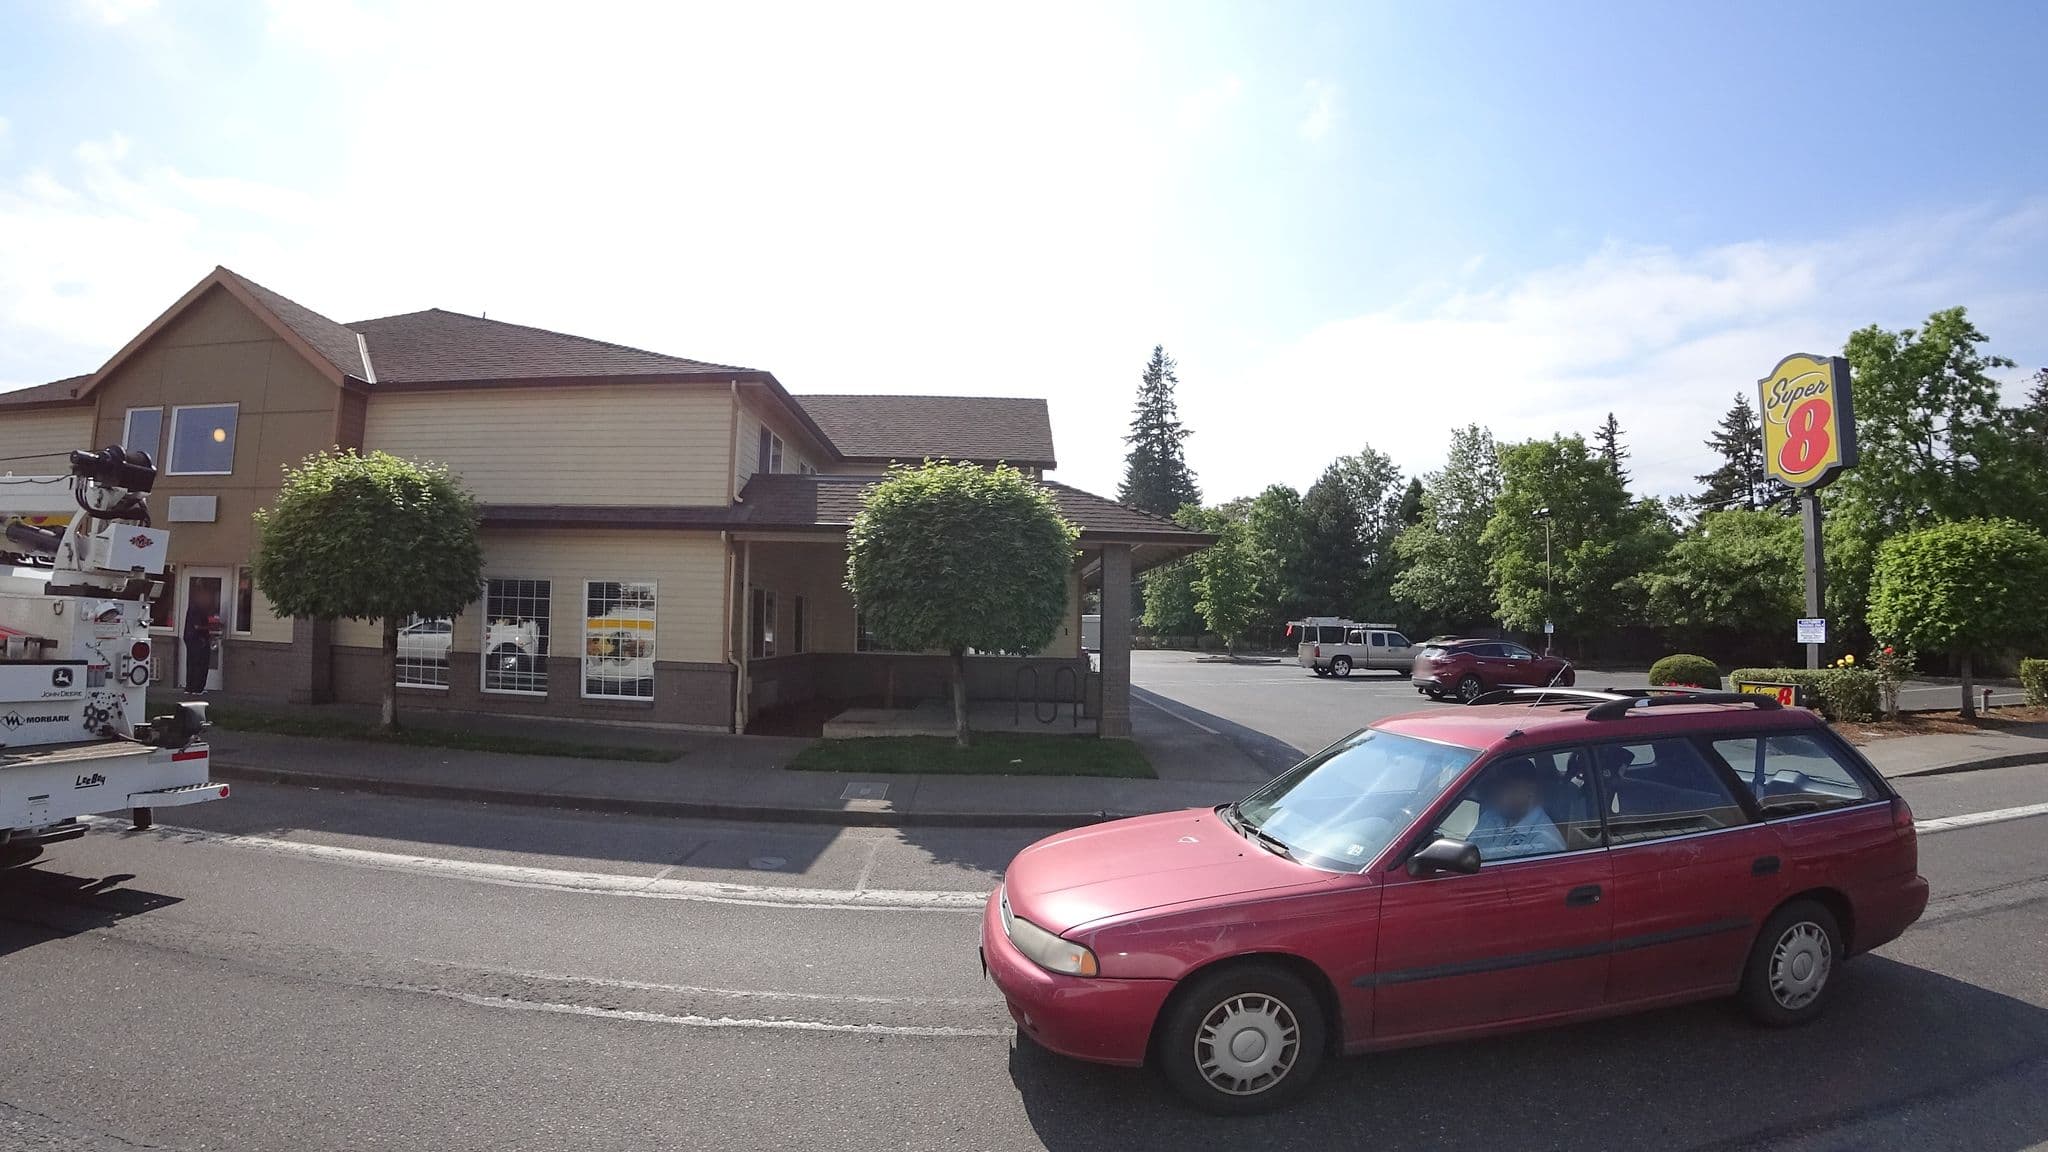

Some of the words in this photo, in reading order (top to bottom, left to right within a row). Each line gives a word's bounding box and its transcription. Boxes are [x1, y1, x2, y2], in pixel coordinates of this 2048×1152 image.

[1767, 376, 1829, 419] Super
[1778, 398, 1831, 474] 8
[1777, 687, 1793, 705] 8
[26, 715, 70, 723] MORBARK
